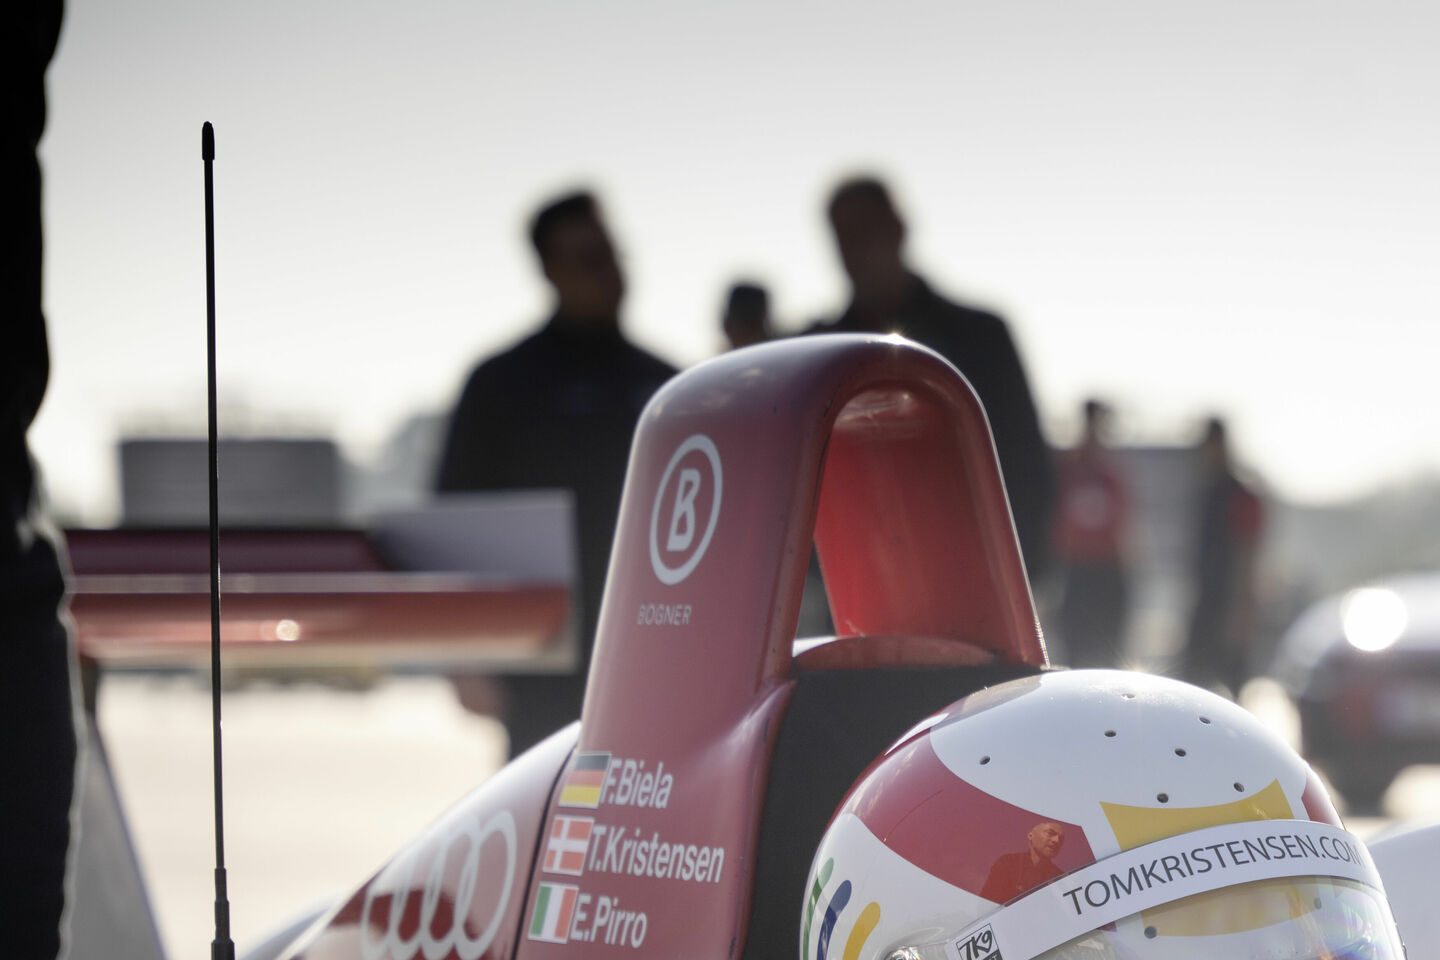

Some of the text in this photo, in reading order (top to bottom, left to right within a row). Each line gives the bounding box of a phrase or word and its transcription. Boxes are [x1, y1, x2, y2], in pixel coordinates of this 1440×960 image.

[666, 468, 702, 552] B
[637, 603, 692, 626] BOGNER
[600, 758, 674, 809] F.Biela
[588, 824, 725, 883] T.Kristensen
[1063, 834, 1366, 915] TOMKRISTENSEN.COM
[569, 893, 648, 948] E.Pirro
